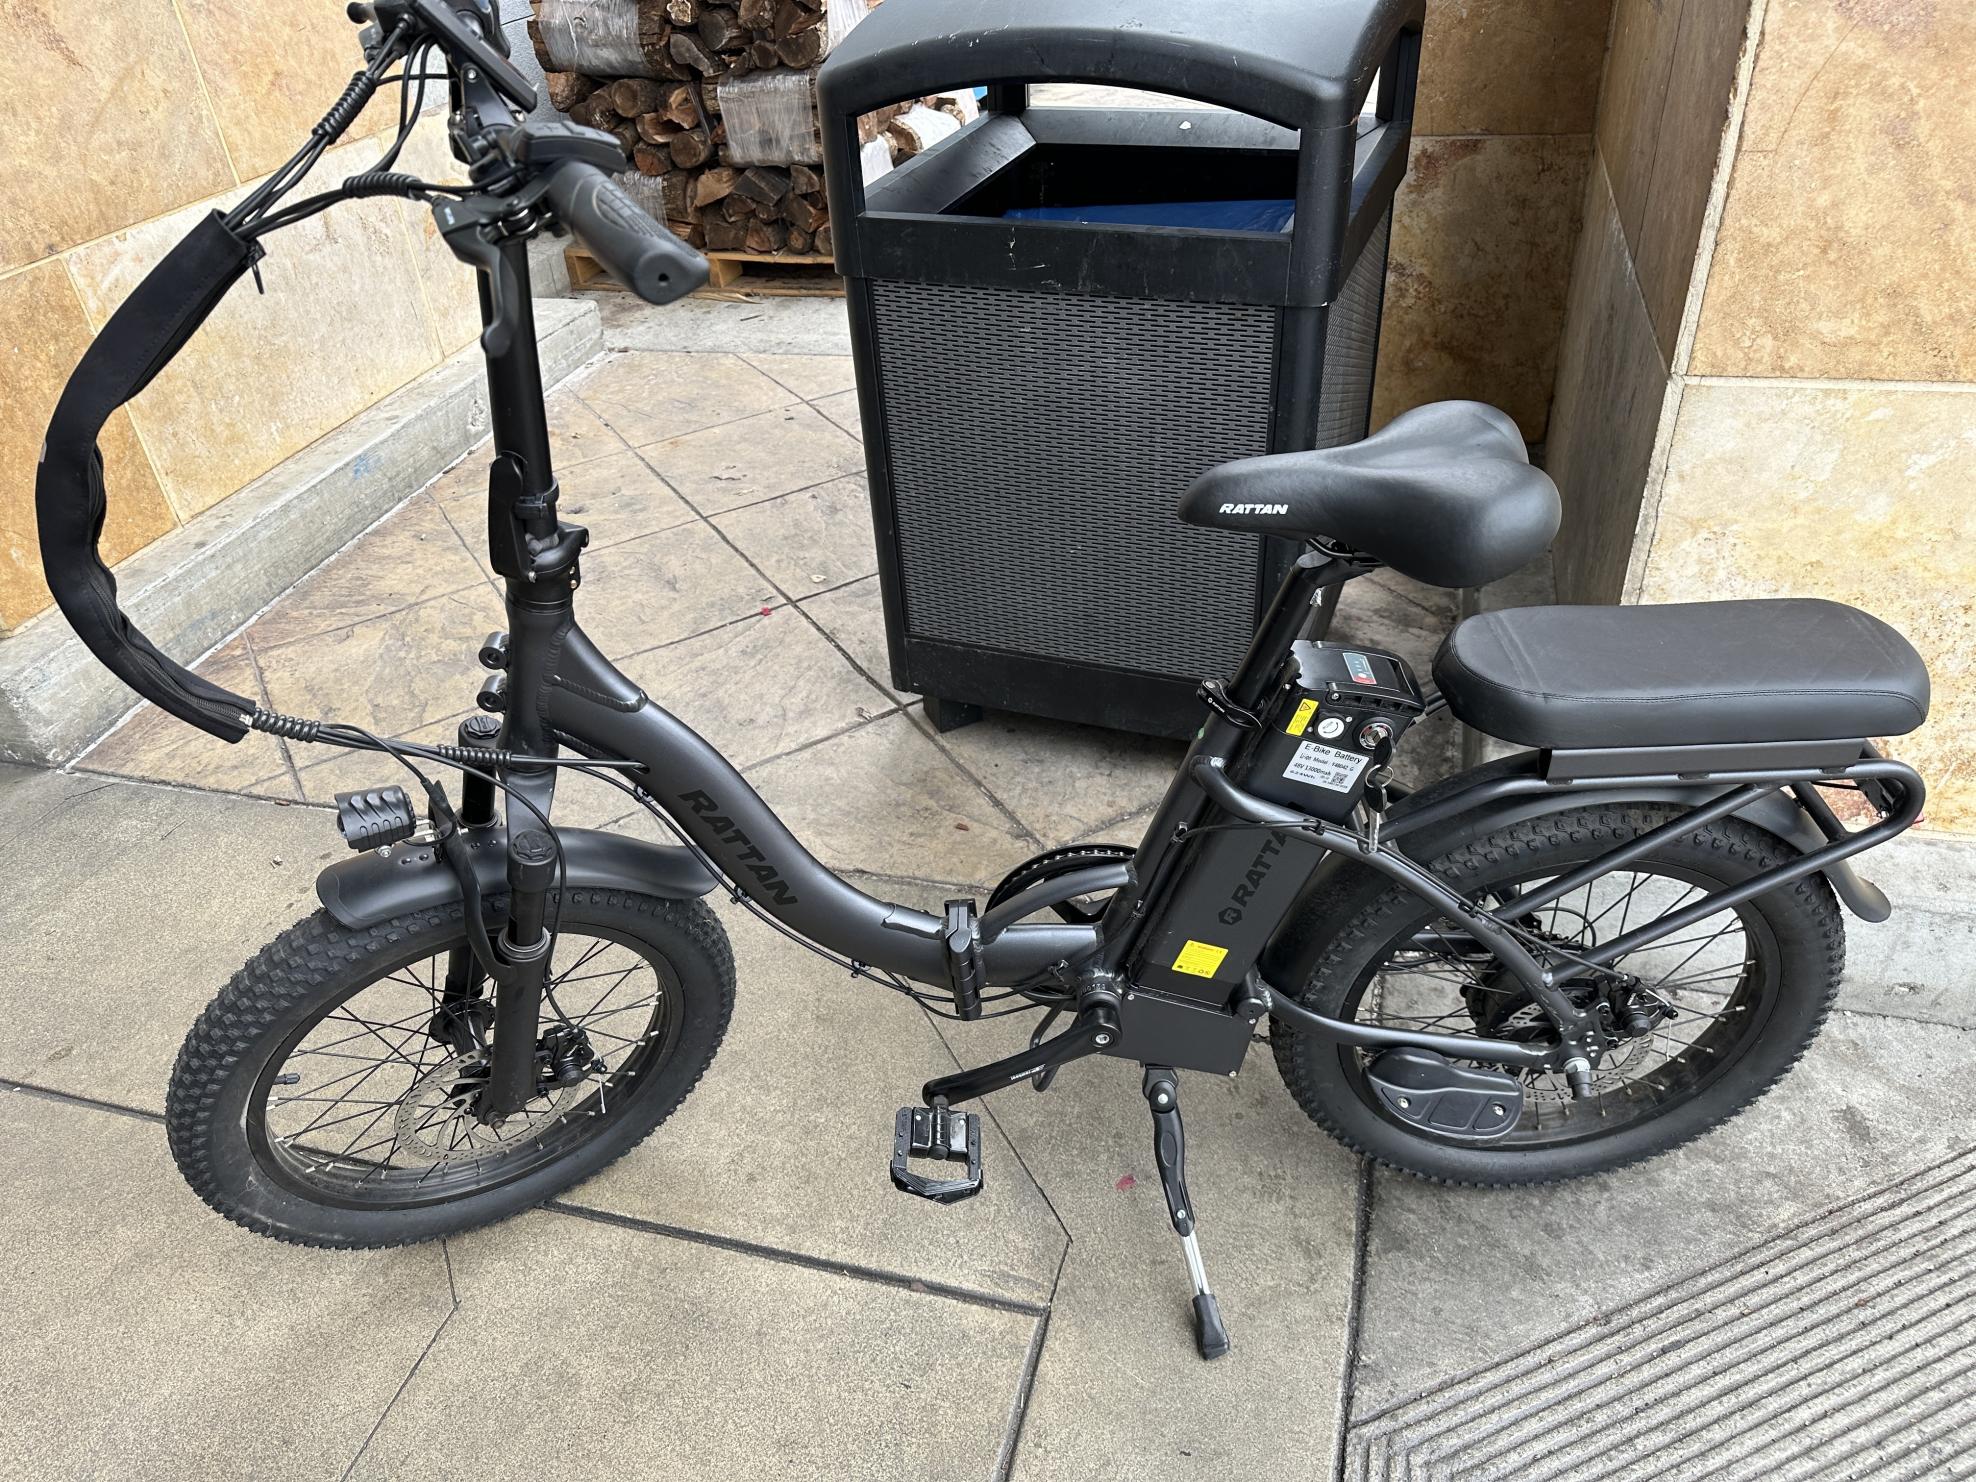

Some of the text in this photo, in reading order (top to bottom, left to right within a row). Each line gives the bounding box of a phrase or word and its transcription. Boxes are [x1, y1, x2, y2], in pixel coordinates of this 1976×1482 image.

[1219, 503, 1289, 515] RATTAN
[1304, 743, 1362, 764] E-Bike Battery
[677, 789, 798, 905] RATTAN
[1231, 830, 1289, 908] RATTA
